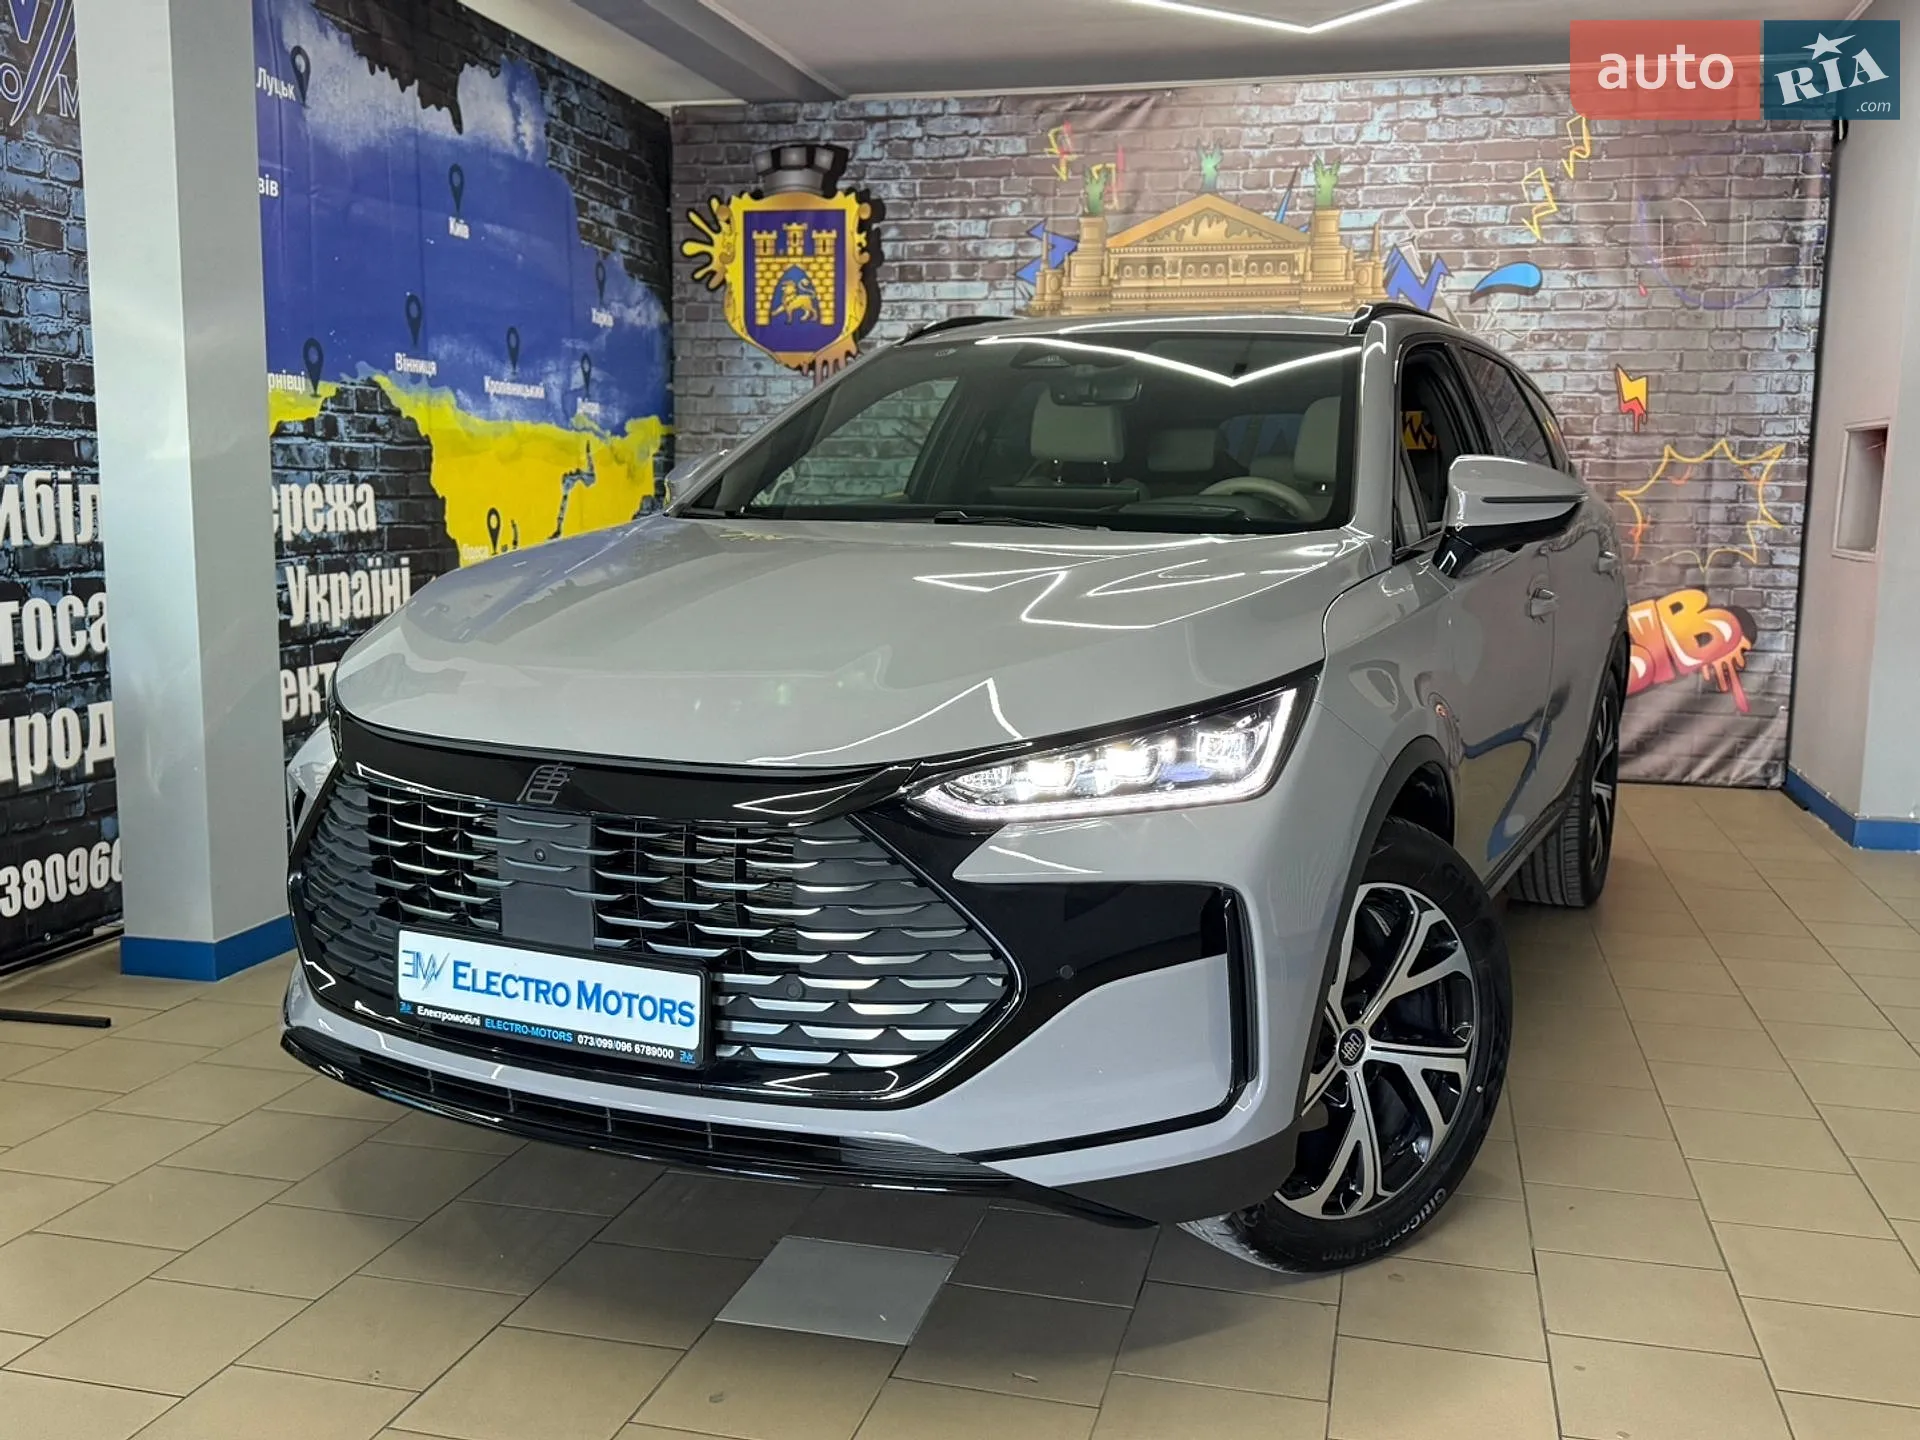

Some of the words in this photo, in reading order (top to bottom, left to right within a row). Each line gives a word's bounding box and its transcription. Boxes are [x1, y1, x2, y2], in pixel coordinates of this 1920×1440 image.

[256, 66, 296, 102] Луцьк
[285, 556, 412, 627] Україні
[453, 960, 572, 1008] ELECTRO
[576, 980, 697, 1028] MOTORS
[417, 1005, 481, 1026] Електромобілі
[484, 1018, 573, 1043] ELECTRO-MOTORS
[577, 1034, 632, 1053] 073/099/096
[634, 1043, 674, 1060] 6789000
